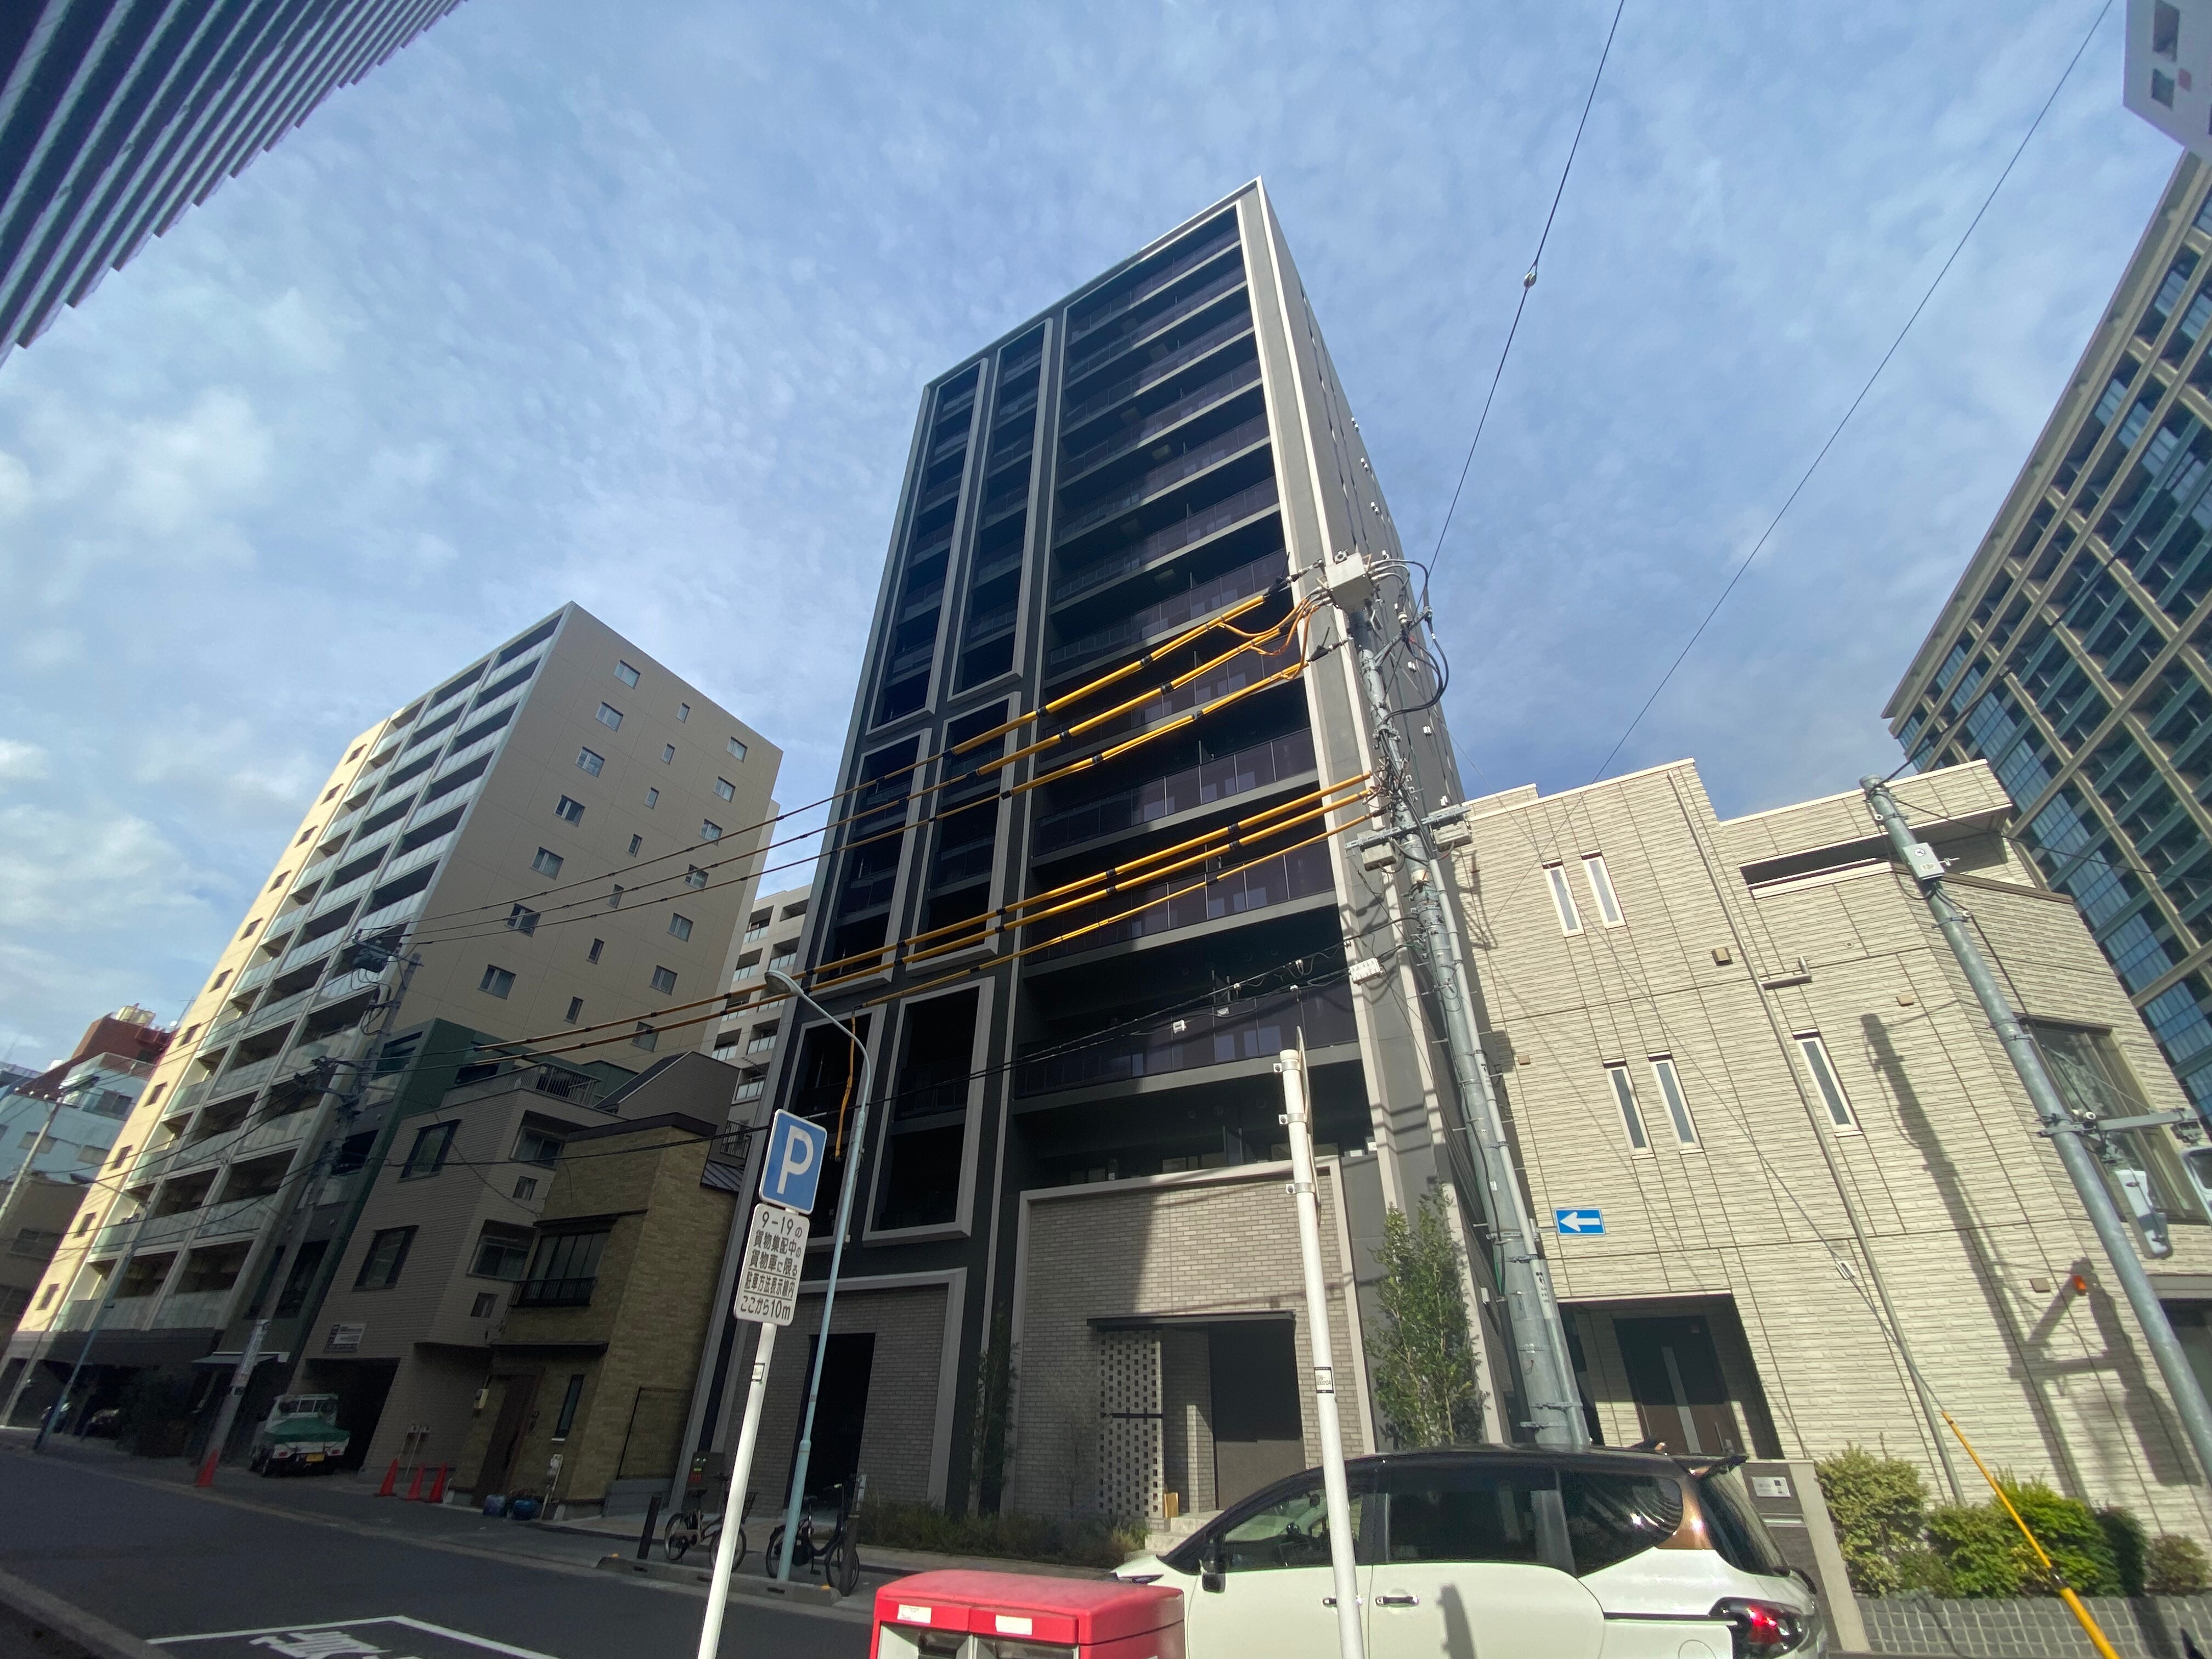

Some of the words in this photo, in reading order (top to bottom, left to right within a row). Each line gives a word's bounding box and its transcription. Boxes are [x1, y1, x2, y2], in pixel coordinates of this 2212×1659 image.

[777, 1125, 814, 1194] P
[753, 1229, 802, 1258] 貨物集配中の
[749, 1249, 798, 1277] 貨物車に限る
[740, 1295, 791, 1320] ここから10m
[249, 1630, 424, 1659] 貨
